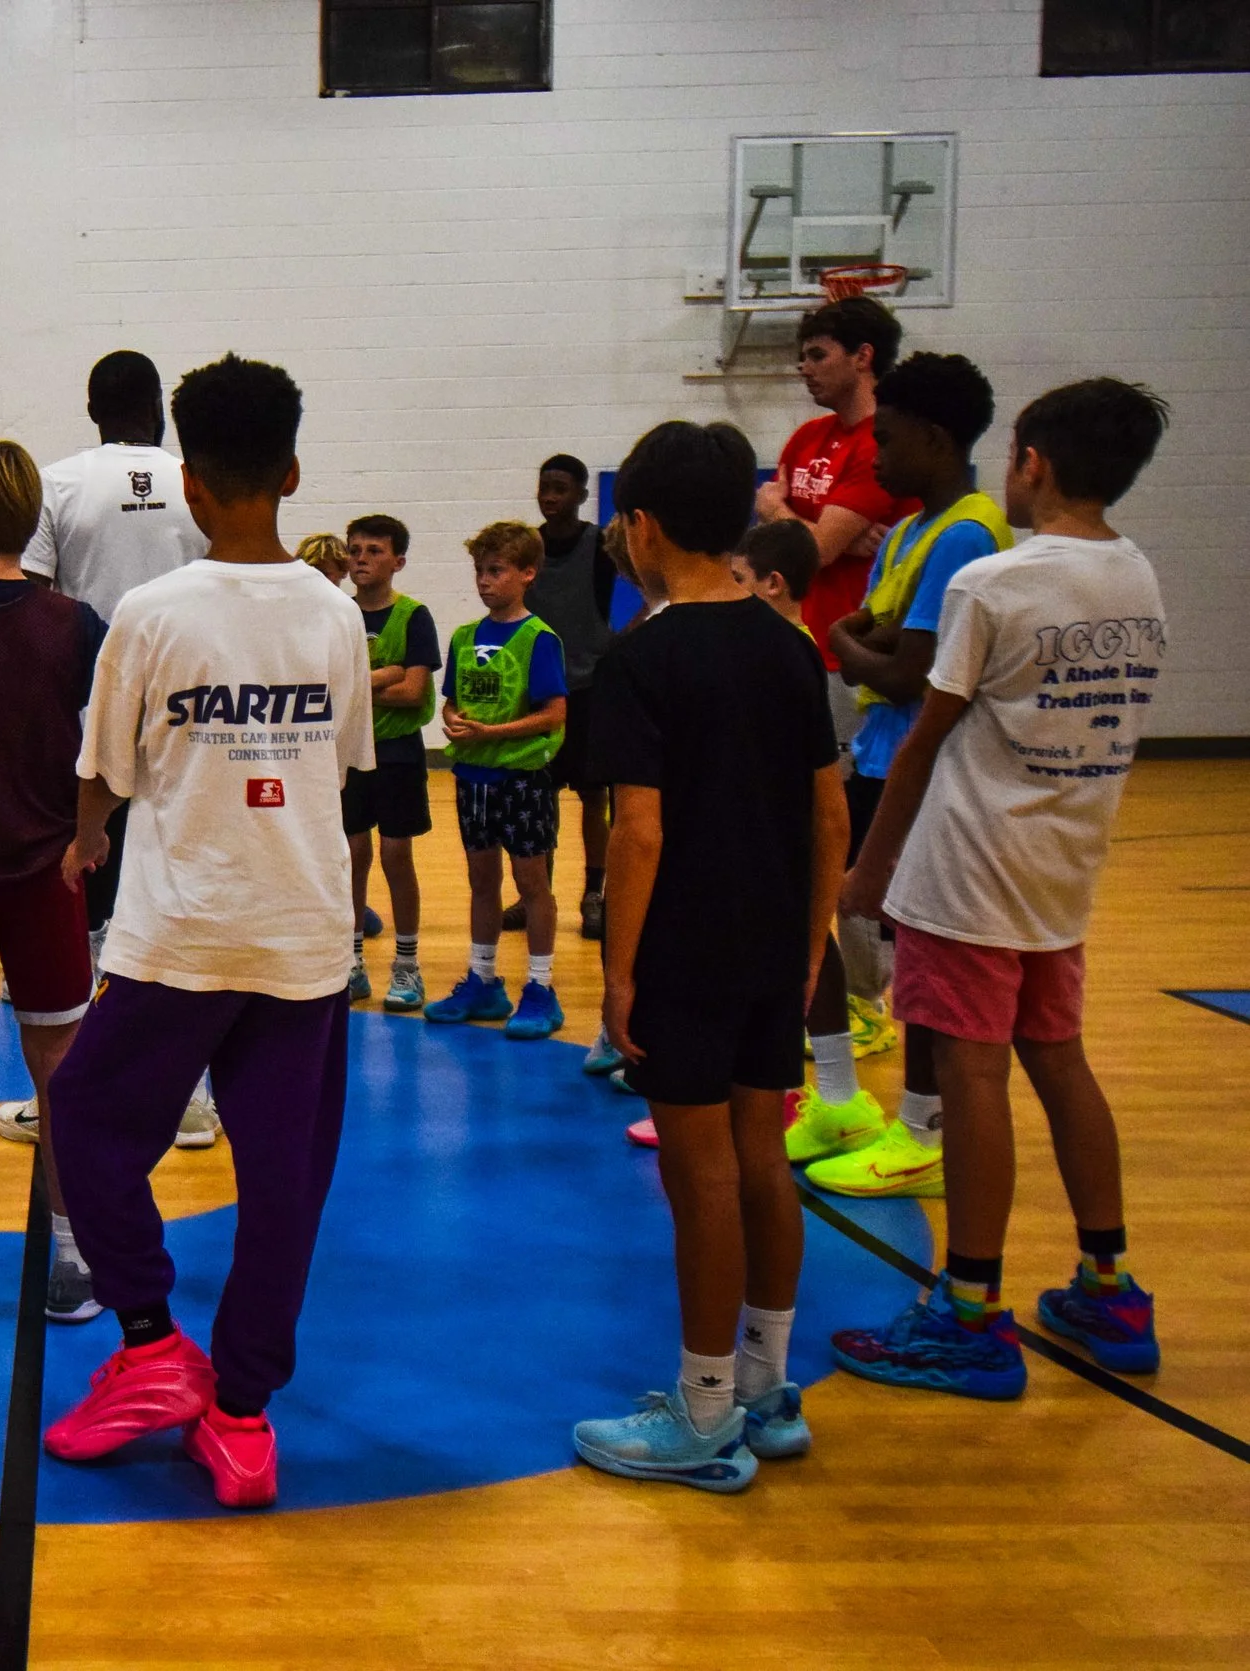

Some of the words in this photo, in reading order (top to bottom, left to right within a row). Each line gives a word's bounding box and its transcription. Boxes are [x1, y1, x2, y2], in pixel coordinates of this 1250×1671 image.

[1042, 669, 1060, 684] A
[1066, 666, 1119, 682] Rhode
[271, 732, 300, 744] NEW
